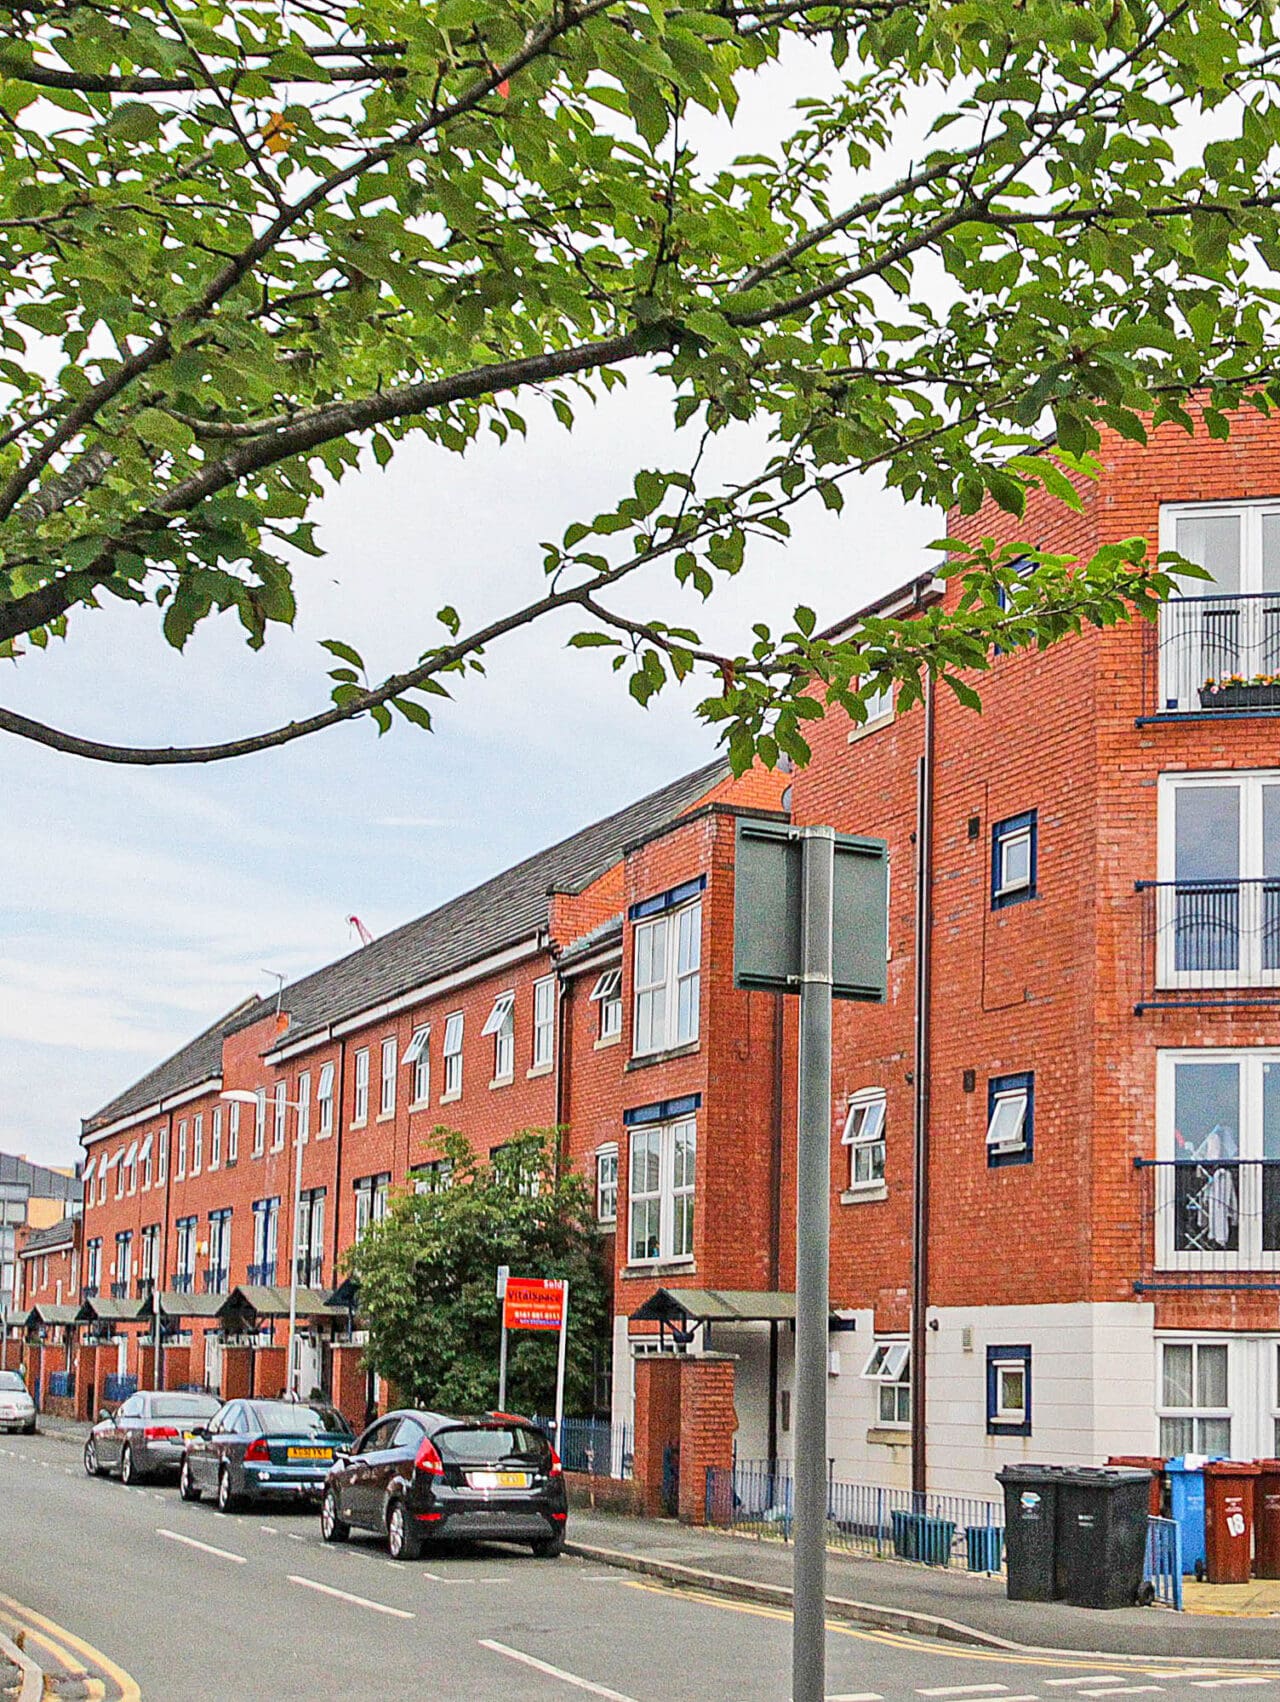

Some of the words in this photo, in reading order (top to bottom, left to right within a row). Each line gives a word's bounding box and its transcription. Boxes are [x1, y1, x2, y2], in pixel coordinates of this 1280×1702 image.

[543, 1279, 562, 1289] Sold
[508, 1290, 560, 1303] VitalSpace
[1226, 1513, 1245, 1537] 18
